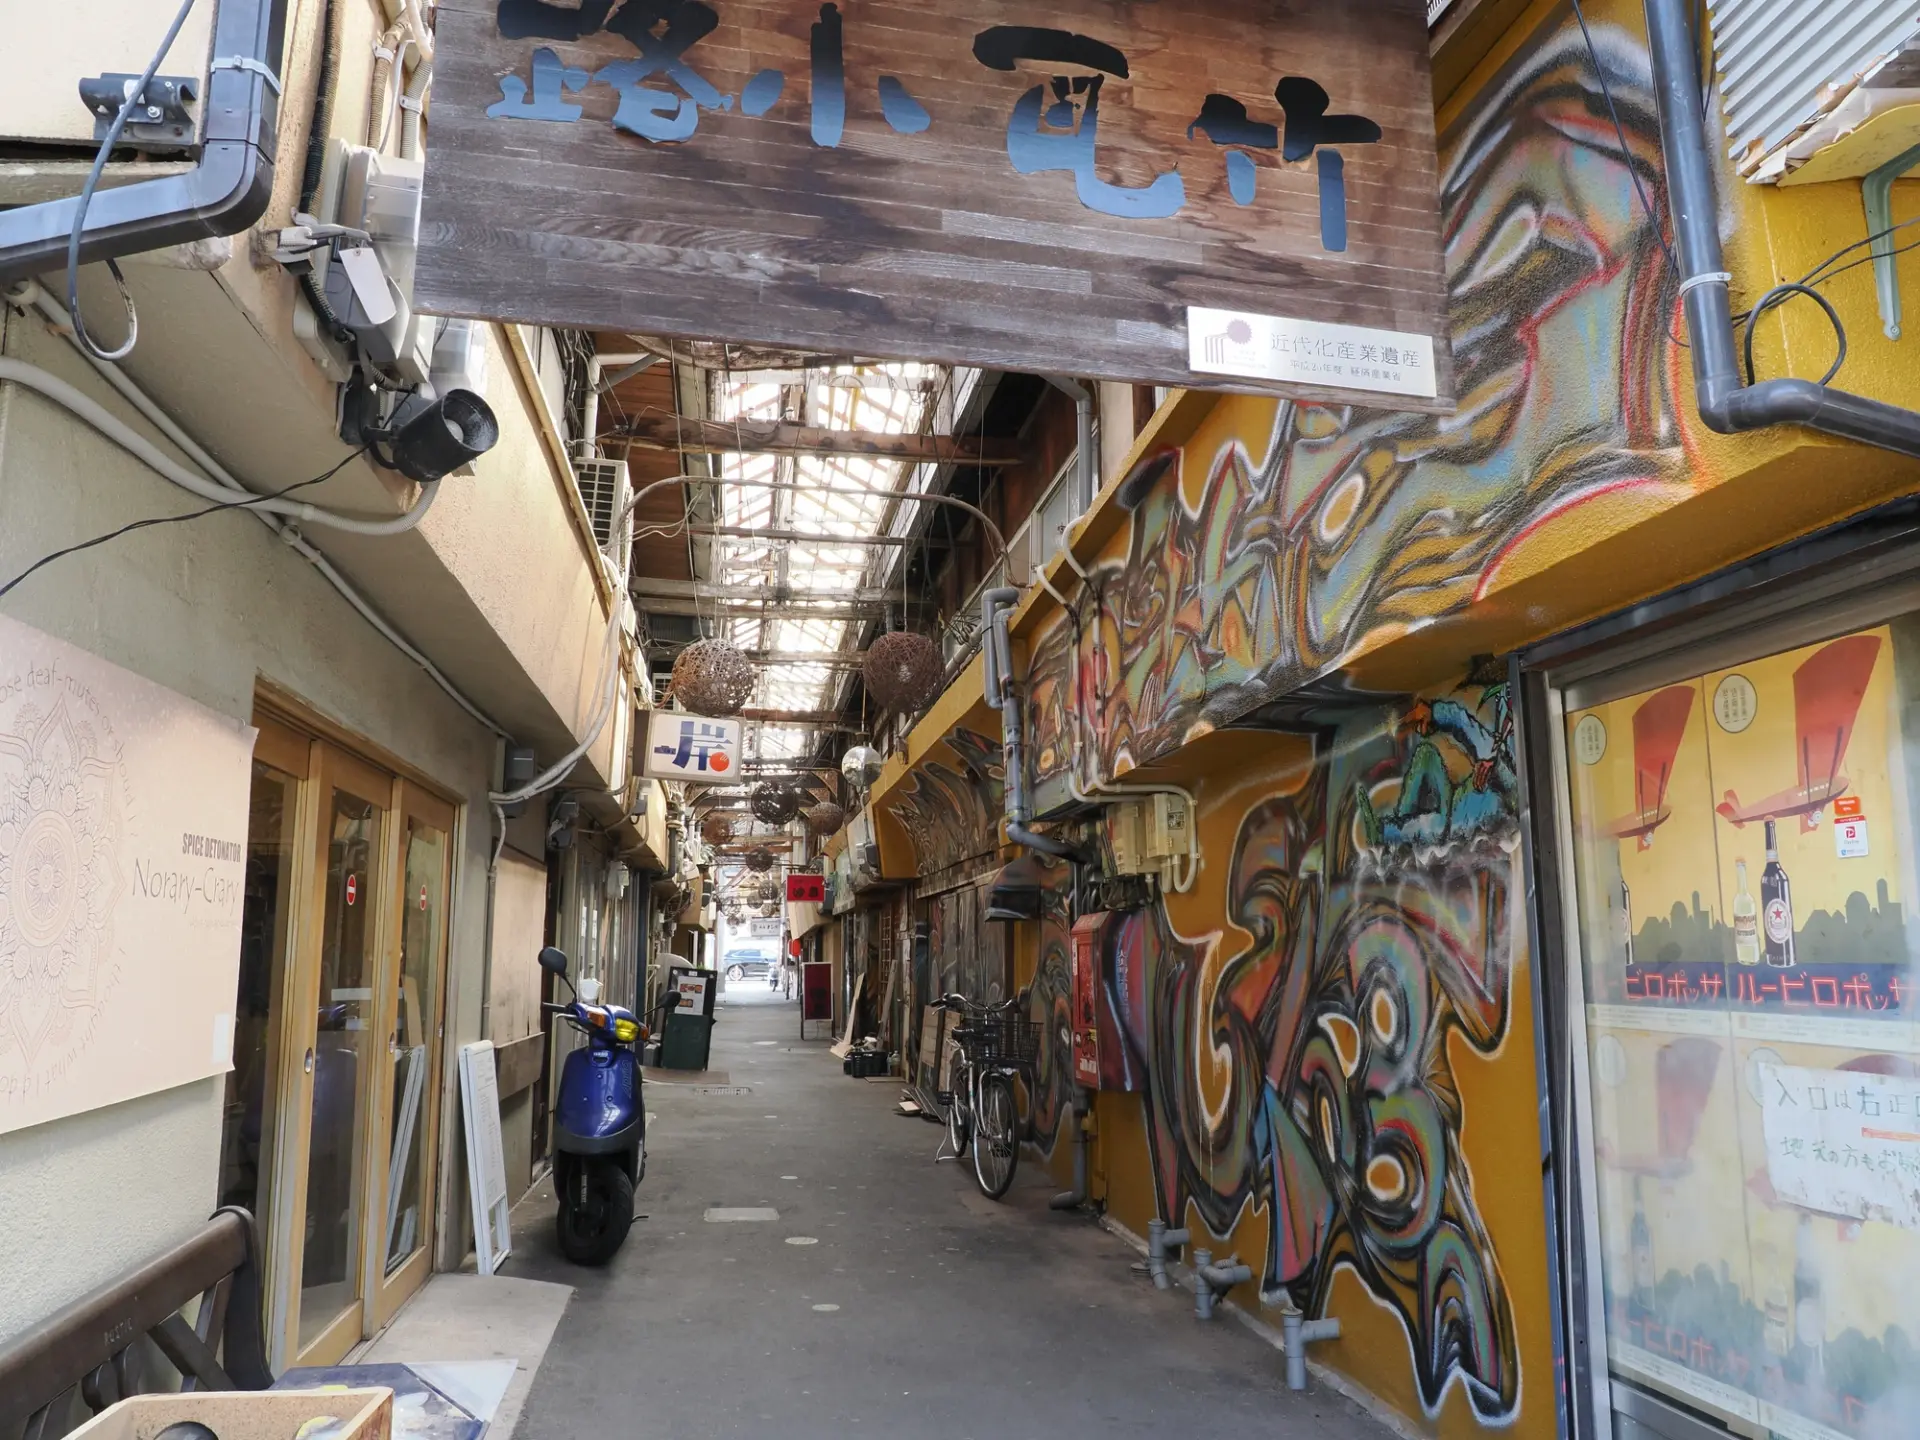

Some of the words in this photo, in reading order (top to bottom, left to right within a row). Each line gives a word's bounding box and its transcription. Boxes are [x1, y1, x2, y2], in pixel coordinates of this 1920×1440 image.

[1271, 333, 1421, 368] 近代化産業遺産
[182, 833, 204, 857] SPICE
[204, 837, 241, 863] DETONATOR
